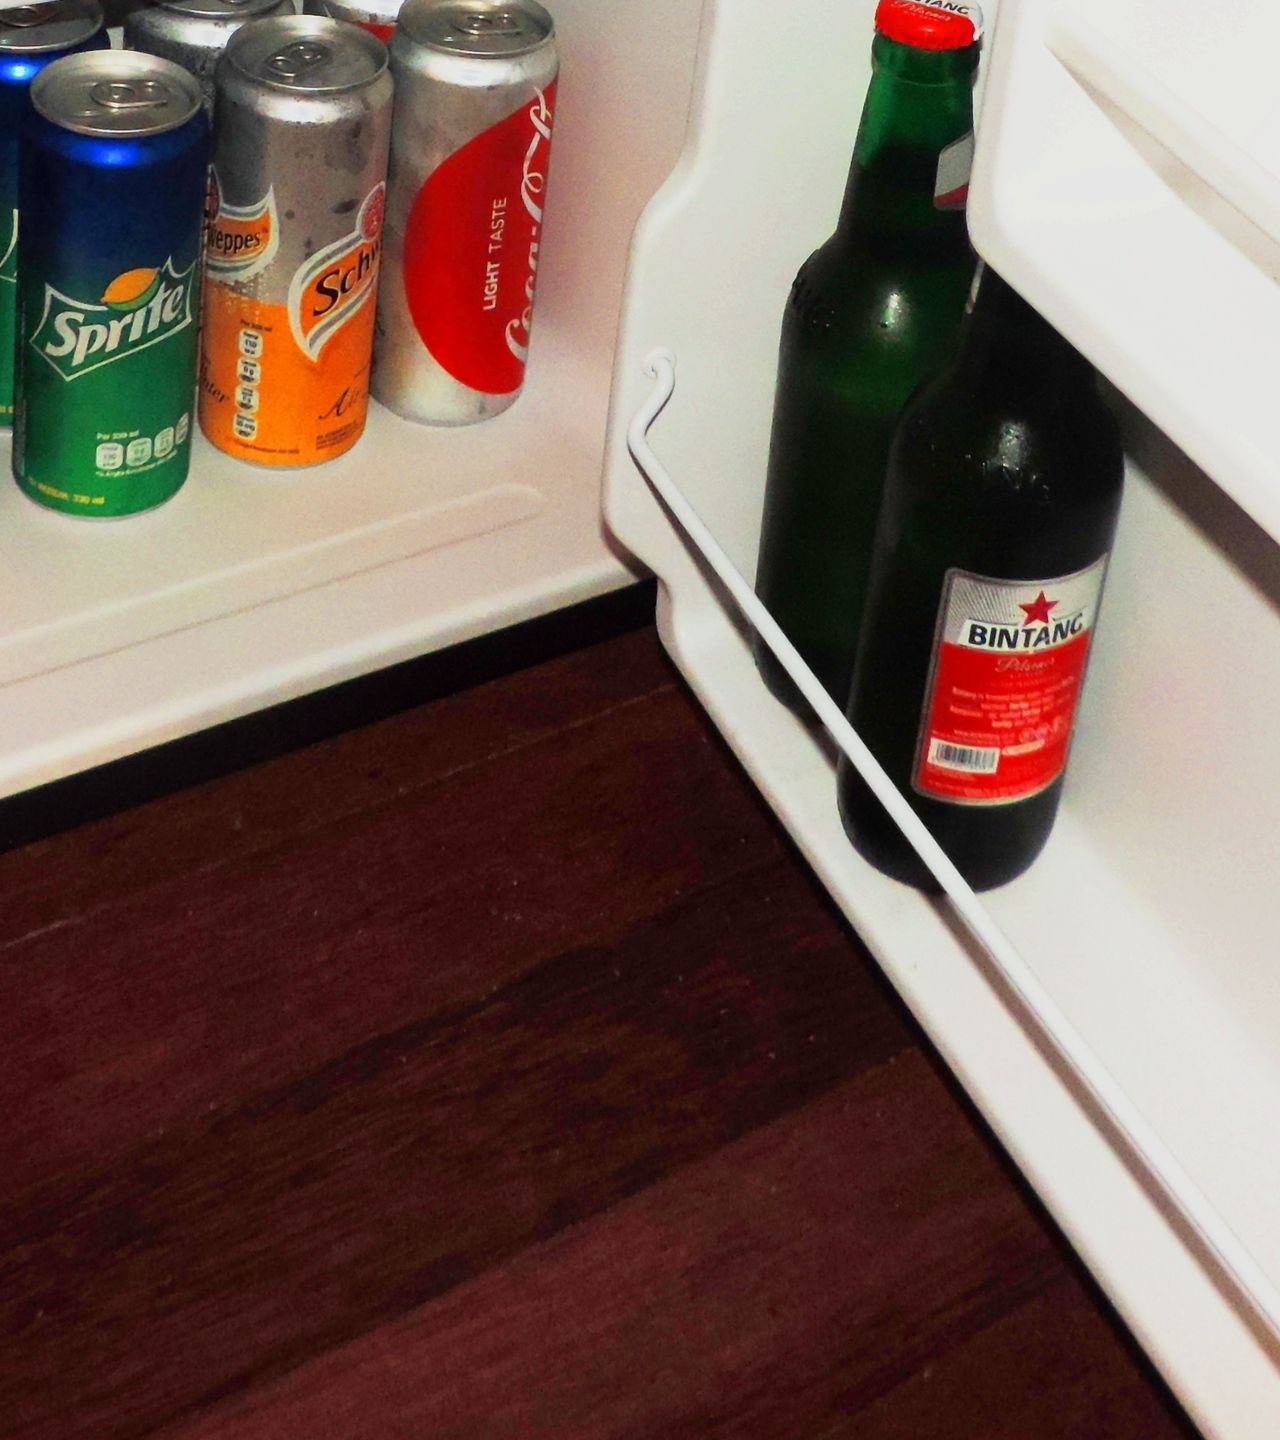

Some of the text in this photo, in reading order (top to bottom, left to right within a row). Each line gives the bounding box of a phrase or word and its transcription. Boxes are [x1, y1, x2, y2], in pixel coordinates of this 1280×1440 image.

[483, 196, 508, 311] LIGHT TASTE
[44, 280, 185, 368] Sprite
[968, 612, 1084, 650] BINTANG
